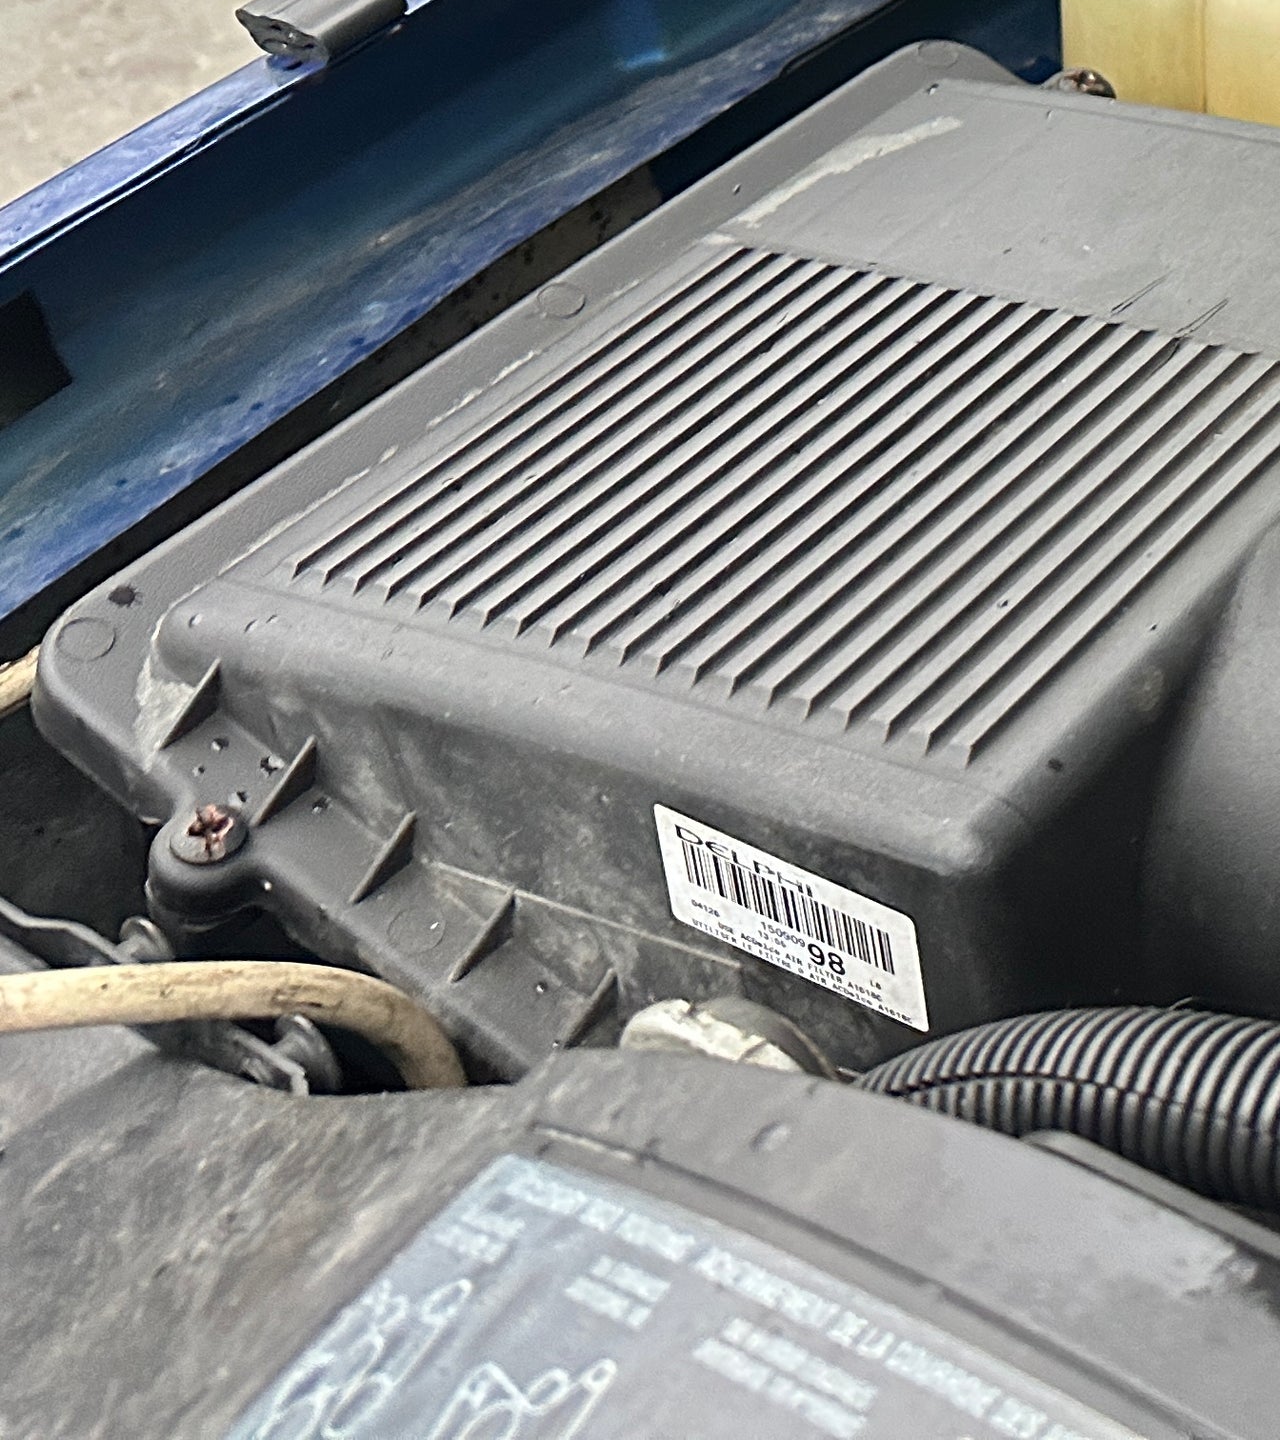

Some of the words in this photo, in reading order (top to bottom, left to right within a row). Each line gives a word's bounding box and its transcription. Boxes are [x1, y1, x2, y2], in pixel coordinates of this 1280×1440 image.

[674, 824, 813, 898] DELPHI
[740, 932, 780, 957] ACDelco
[784, 953, 803, 967] AIR
[807, 963, 843, 984] FILTER
[807, 942, 846, 976] 98
[809, 972, 827, 986] AIR
